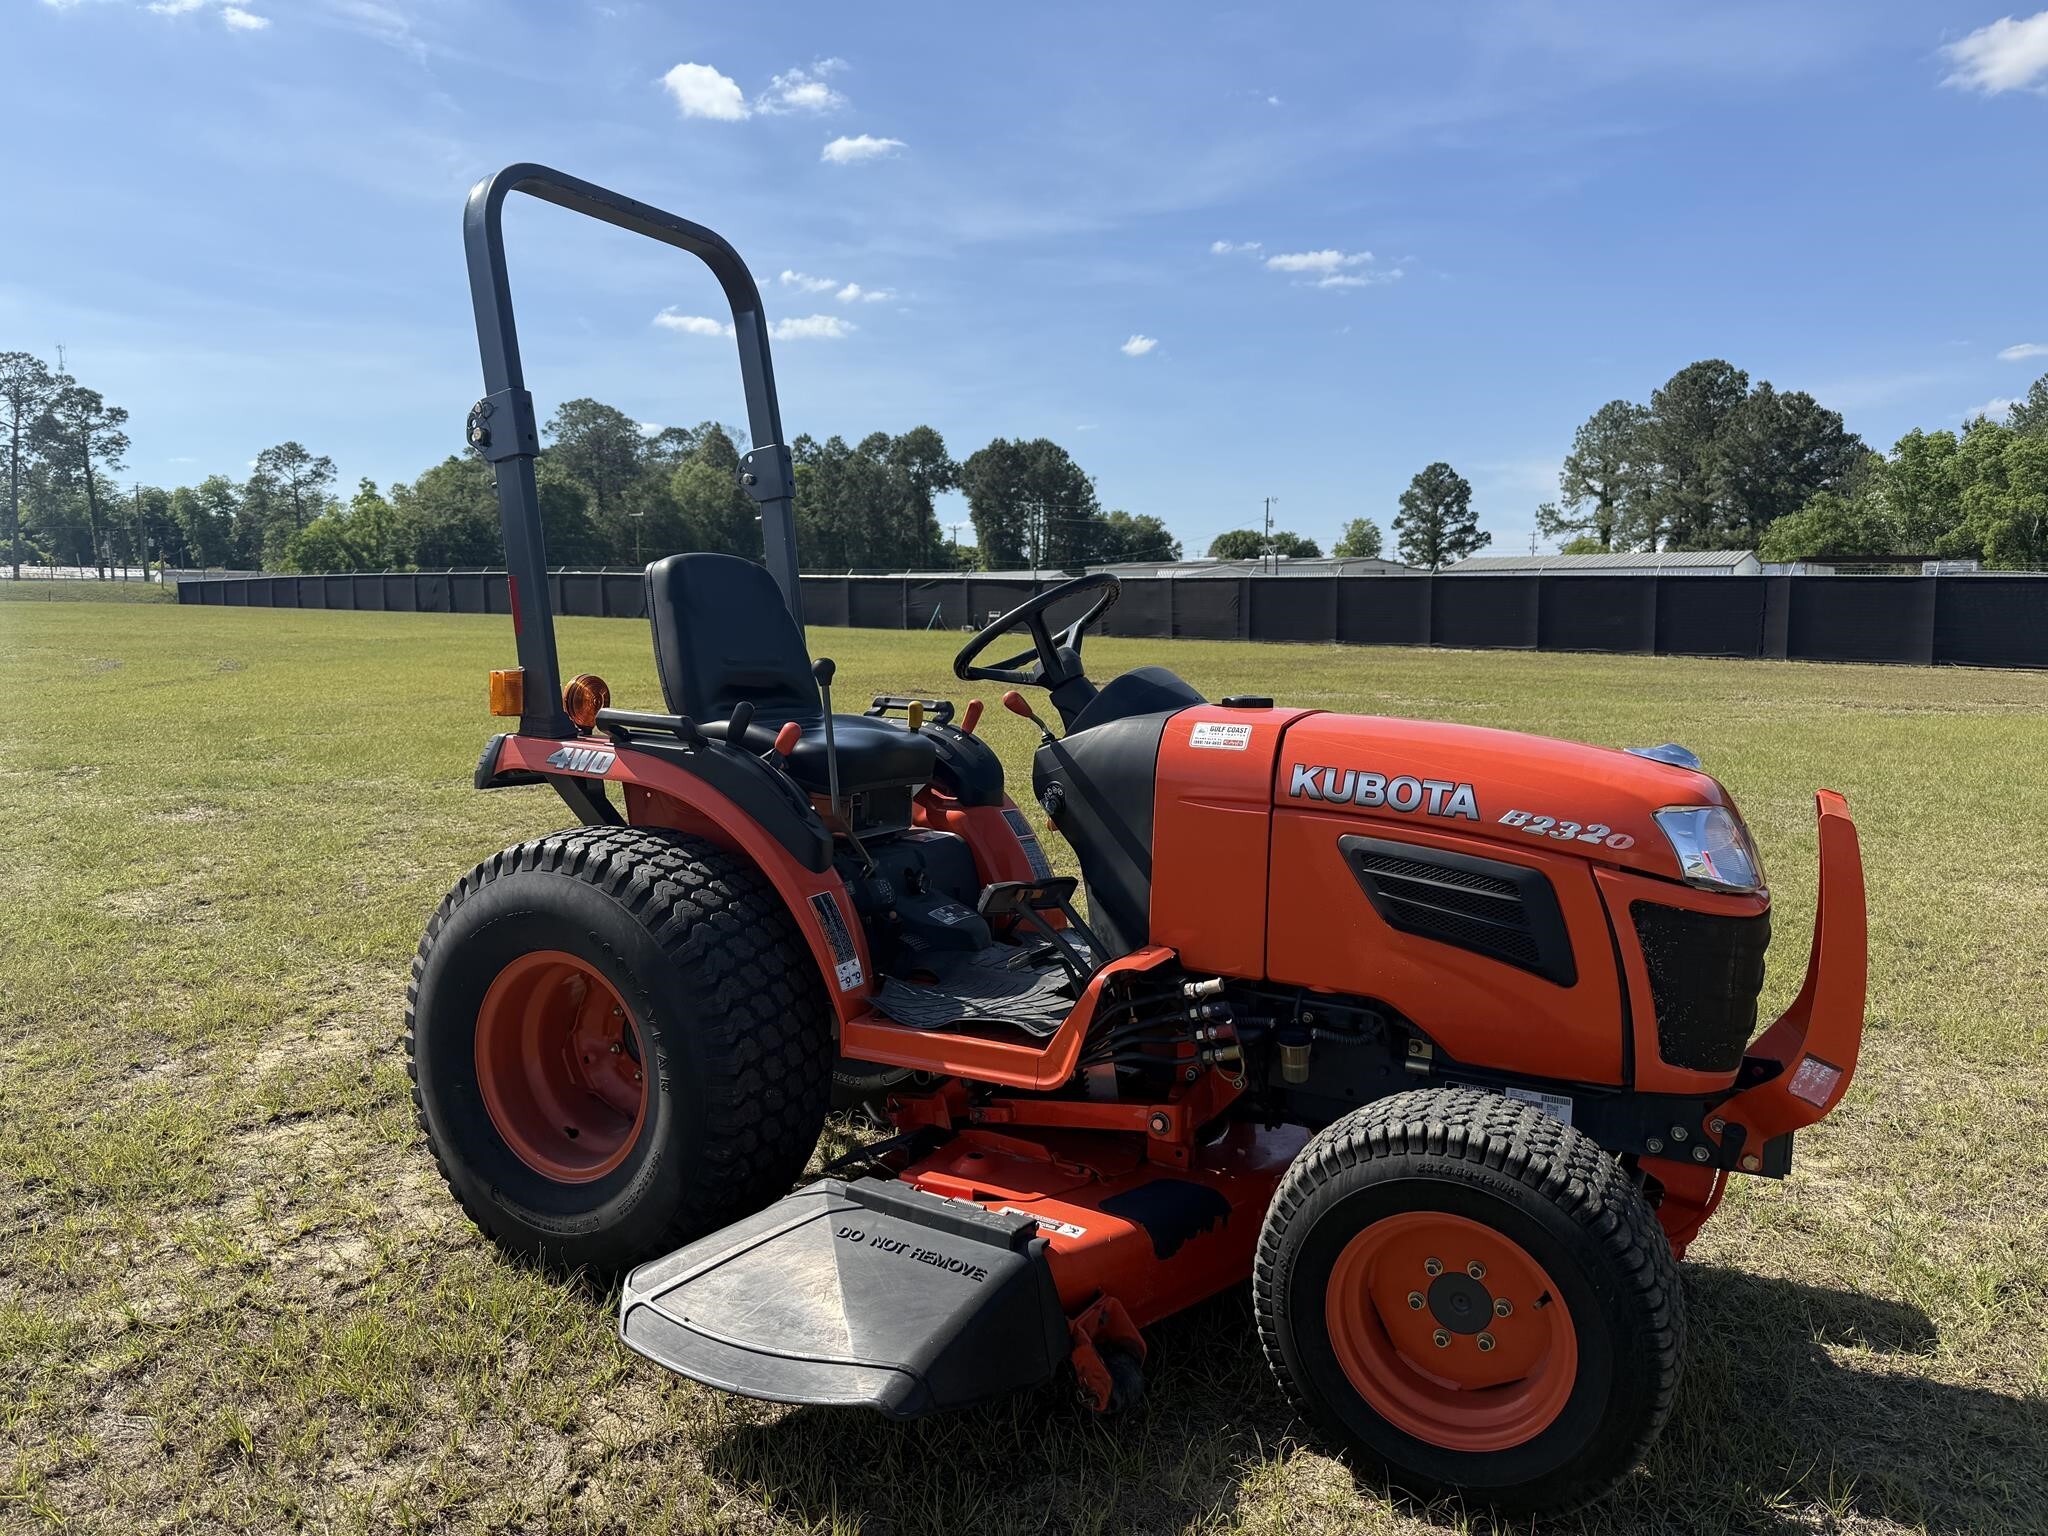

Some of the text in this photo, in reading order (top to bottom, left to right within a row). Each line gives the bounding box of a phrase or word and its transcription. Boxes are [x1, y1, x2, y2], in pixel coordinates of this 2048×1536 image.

[1210, 725, 1248, 734] GULF COAST
[546, 746, 617, 775] 4WD
[1289, 762, 1480, 822] KUBOTA
[1498, 808, 1635, 850] B2320
[836, 1226, 988, 1284] DO NOT REMOVE
